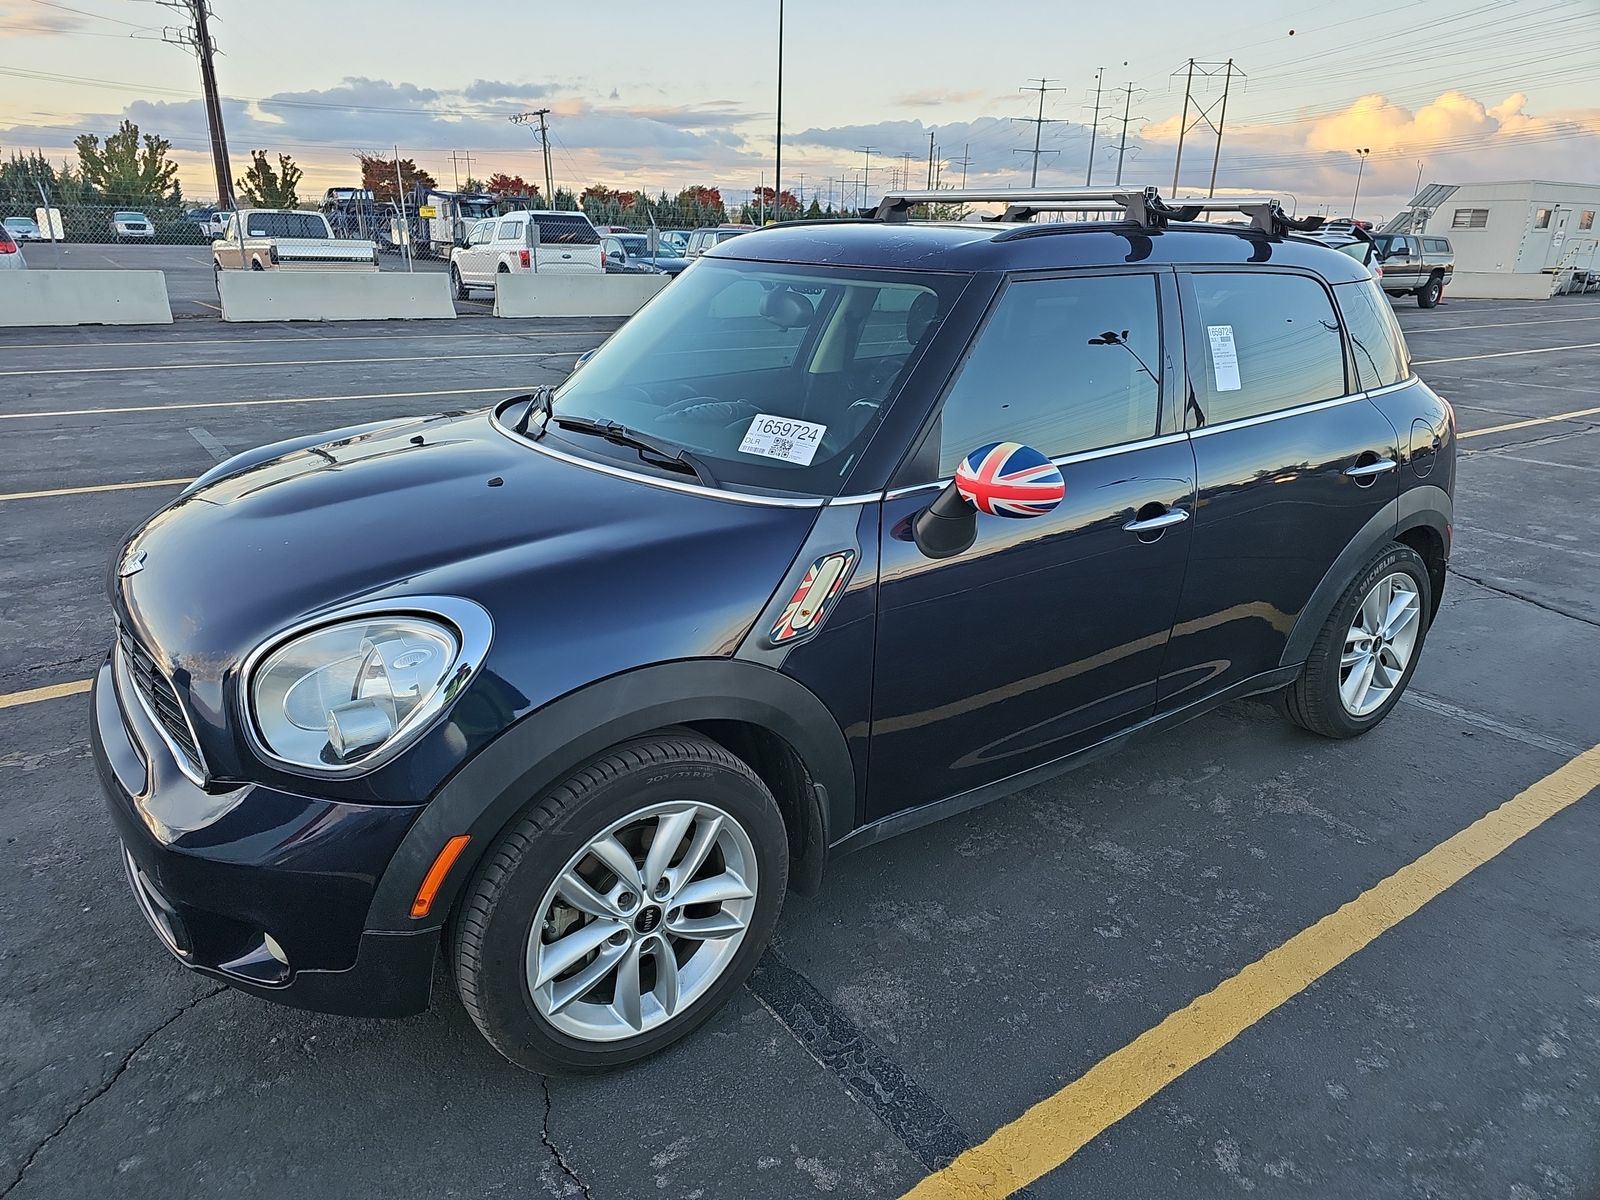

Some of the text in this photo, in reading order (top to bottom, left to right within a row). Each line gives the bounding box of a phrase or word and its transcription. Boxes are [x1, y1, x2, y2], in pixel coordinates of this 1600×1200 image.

[745, 437, 760, 445] DLR
[757, 419, 818, 442] 1659724
[1359, 555, 1396, 594] MICHELIN
[643, 909, 653, 931] MINI
